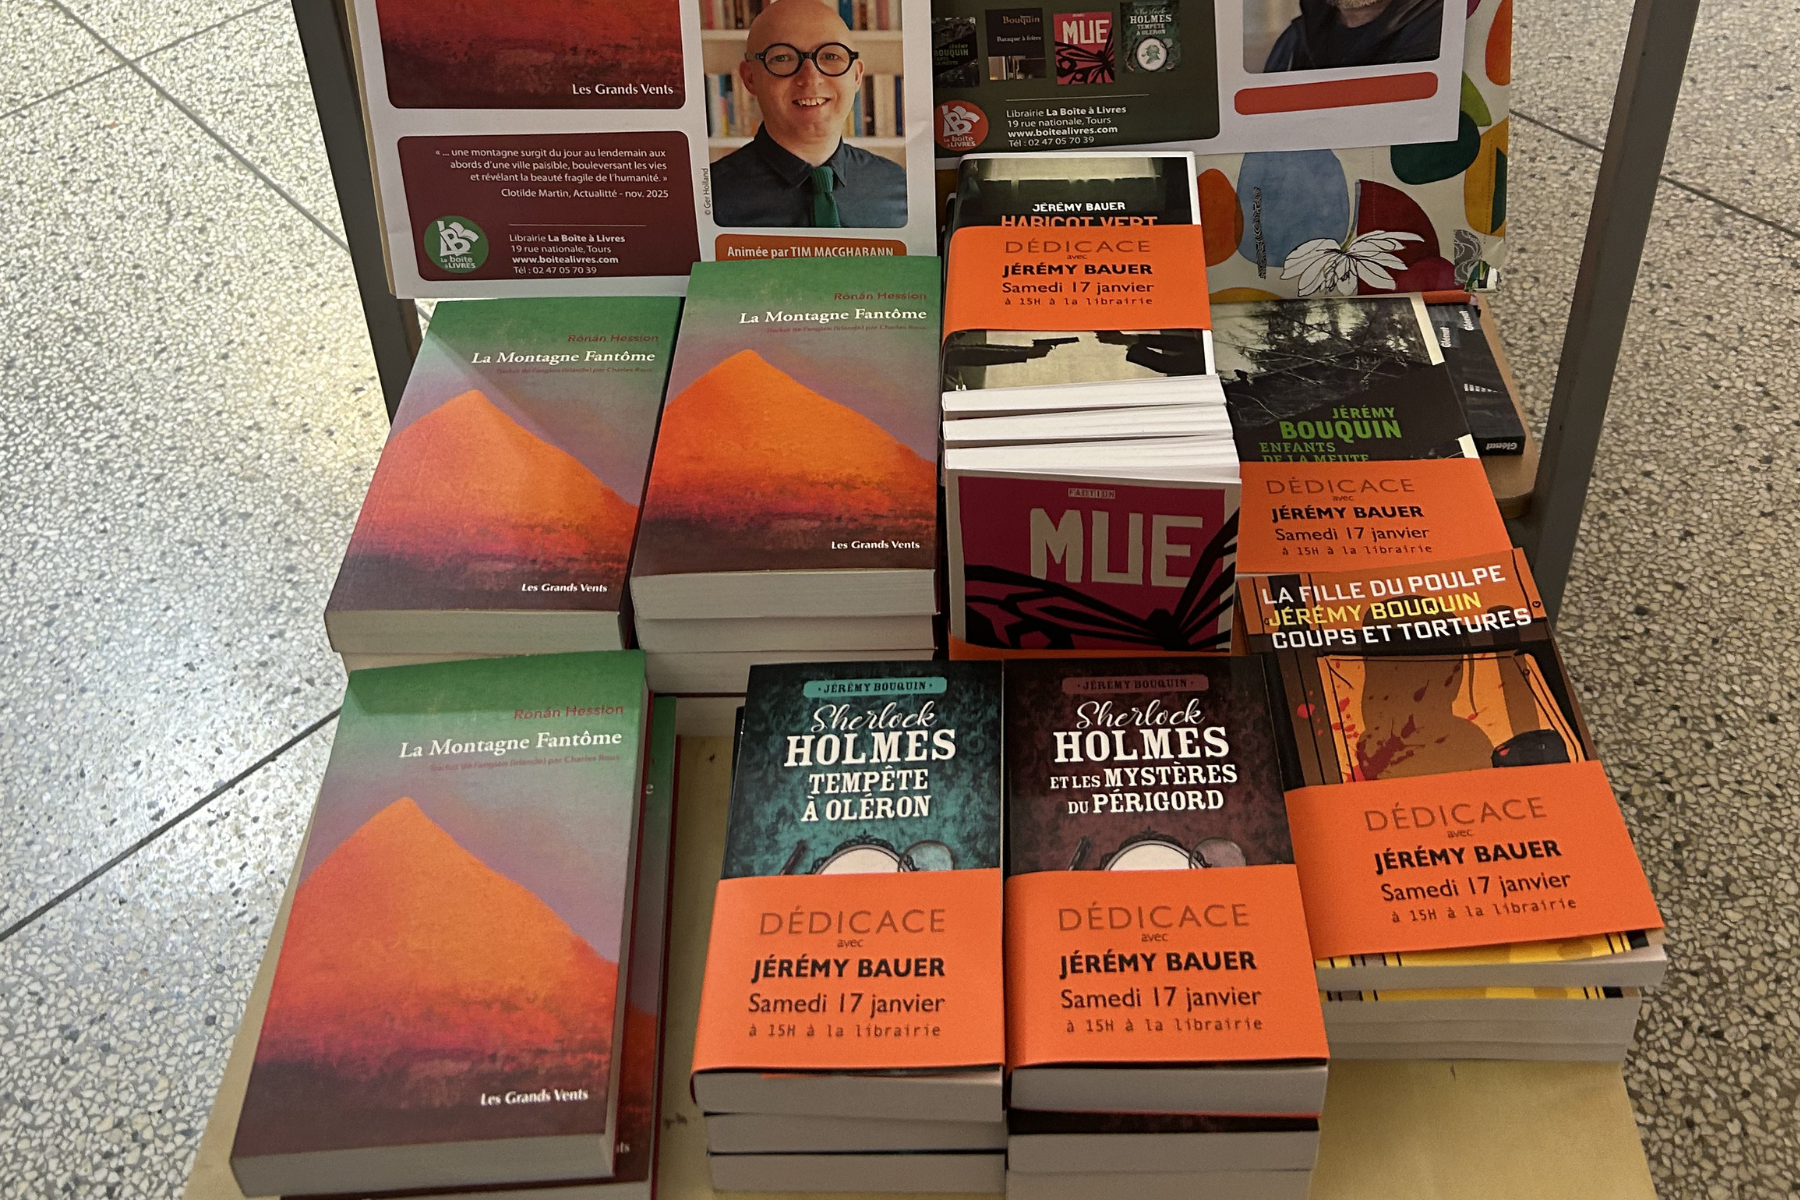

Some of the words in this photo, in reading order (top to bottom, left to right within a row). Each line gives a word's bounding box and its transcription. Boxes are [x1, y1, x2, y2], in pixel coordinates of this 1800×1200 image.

[1003, 15, 1040, 26] Bouquin
[1130, 14, 1172, 24] HOLMES
[1062, 19, 1110, 44] MUE
[572, 84, 592, 95] Les
[595, 83, 638, 95] Grands
[641, 84, 674, 95] Vents
[471, 149, 518, 159] montagne
[521, 149, 547, 159] surgit
[549, 149, 562, 157] du
[563, 149, 582, 159] jour
[598, 149, 647, 157] lendemain
[649, 150, 666, 158] aux
[450, 161, 482, 169] abords
[484, 161, 509, 169] d'une
[512, 161, 530, 170] ville
[532, 161, 570, 171] paisible,
[572, 161, 632, 170] bouleversant
[634, 161, 647, 170] les
[649, 162, 667, 170] vies
[501, 189, 536, 198] Clotilde
[538, 189, 571, 199] Martin,
[573, 189, 618, 198] Actualitté
[646, 190, 669, 198] 2025
[1032, 202, 1082, 212] JÉRÉMY
[1086, 202, 1126, 211] BAUER
[727, 246, 768, 257] Animée
[771, 248, 789, 259] par
[791, 247, 811, 257] TIM
[1005, 238, 1150, 254] DÉDICACE
[512, 256, 619, 264] www.boitealivres.com
[1002, 262, 1077, 278] JÉRÉMY
[1084, 264, 1153, 275] BAUER
[1002, 282, 1062, 293] Samedi
[1072, 282, 1090, 293] 17
[1097, 282, 1154, 295] janvier
[1332, 405, 1395, 419] JÉRÉMY
[1279, 419, 1402, 443] BOUQUIN
[1259, 442, 1336, 453] ENFANTS
[1030, 507, 1203, 588] MUE
[1261, 587, 1294, 605] LA
[1299, 581, 1366, 602] FILLE
[1370, 577, 1403, 598] DU
[1407, 564, 1506, 593] POULPE
[1269, 604, 1361, 627] JÉRÉMY
[1370, 592, 1482, 620] BOUQUIN
[1272, 627, 1357, 649] COUPS
[1362, 624, 1393, 644] ET
[1397, 607, 1532, 640] TORTURES
[824, 681, 870, 693] JÉRÉMY
[873, 681, 926, 692] BOUQUIN
[1083, 678, 1131, 691] JÉRÉMY
[1134, 679, 1188, 689] BOUQUIN
[811, 700, 938, 733] Sherlock
[1076, 698, 1206, 729] Sherlock
[399, 741, 423, 758] La
[429, 737, 530, 756] Montagne
[536, 730, 622, 749] Fantôme
[784, 728, 956, 767] HOLMES
[1053, 726, 1230, 763] HOLMES
[809, 765, 929, 794] TEMPÊTE
[1050, 777, 1069, 789] ET
[1072, 776, 1101, 789] LES
[1103, 762, 1238, 788] MYSTÈRES
[801, 795, 819, 822] À
[825, 794, 931, 821] OLÉRON
[1067, 801, 1089, 814] DU
[1092, 788, 1224, 814] PÉRIGORD
[480, 1091, 502, 1107] Les
[505, 1089, 551, 1105] Grands
[553, 1087, 589, 1103] Vents
